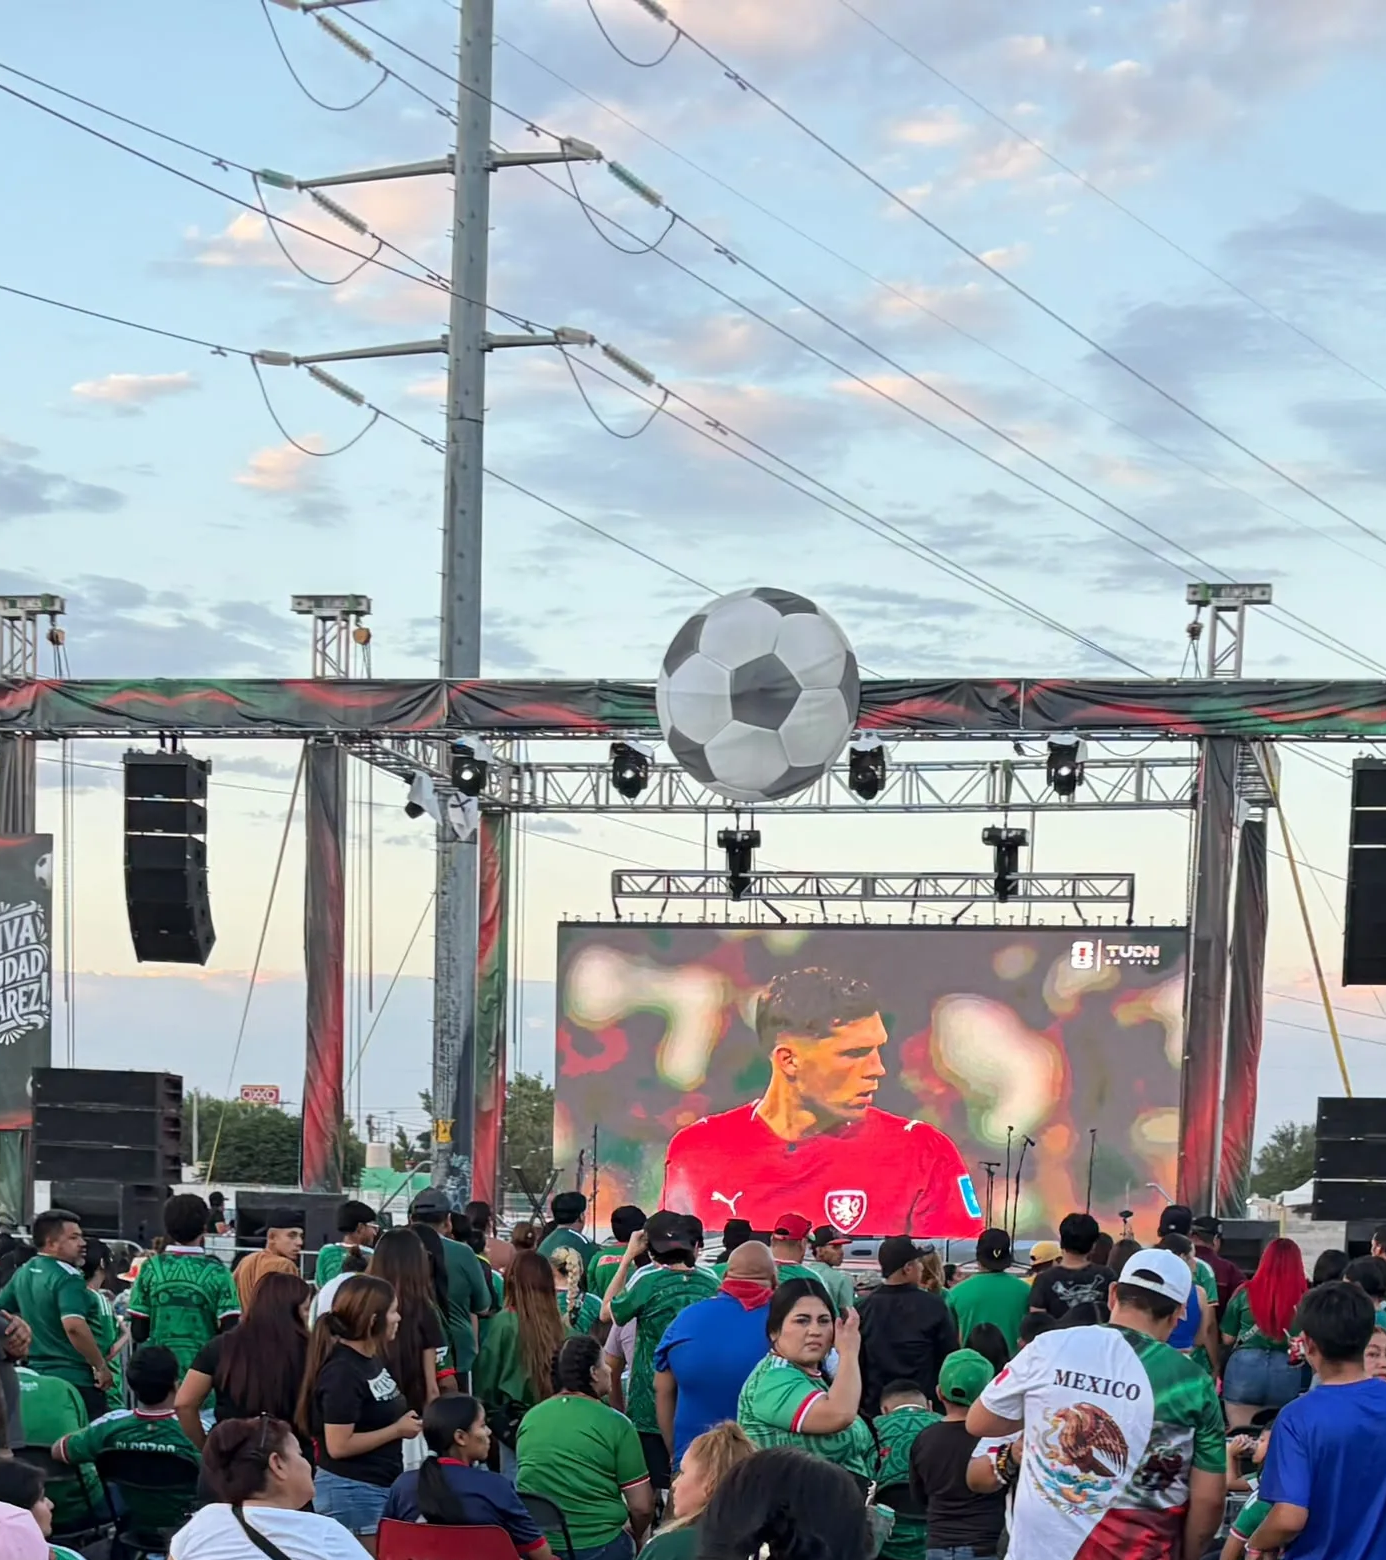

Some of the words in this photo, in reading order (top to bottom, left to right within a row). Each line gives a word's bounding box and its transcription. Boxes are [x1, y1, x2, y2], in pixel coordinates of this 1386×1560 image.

[1106, 945, 1160, 958] TUDN
[242, 1089, 277, 1101] OXXO
[1053, 1369, 1141, 1400] MEXICO
